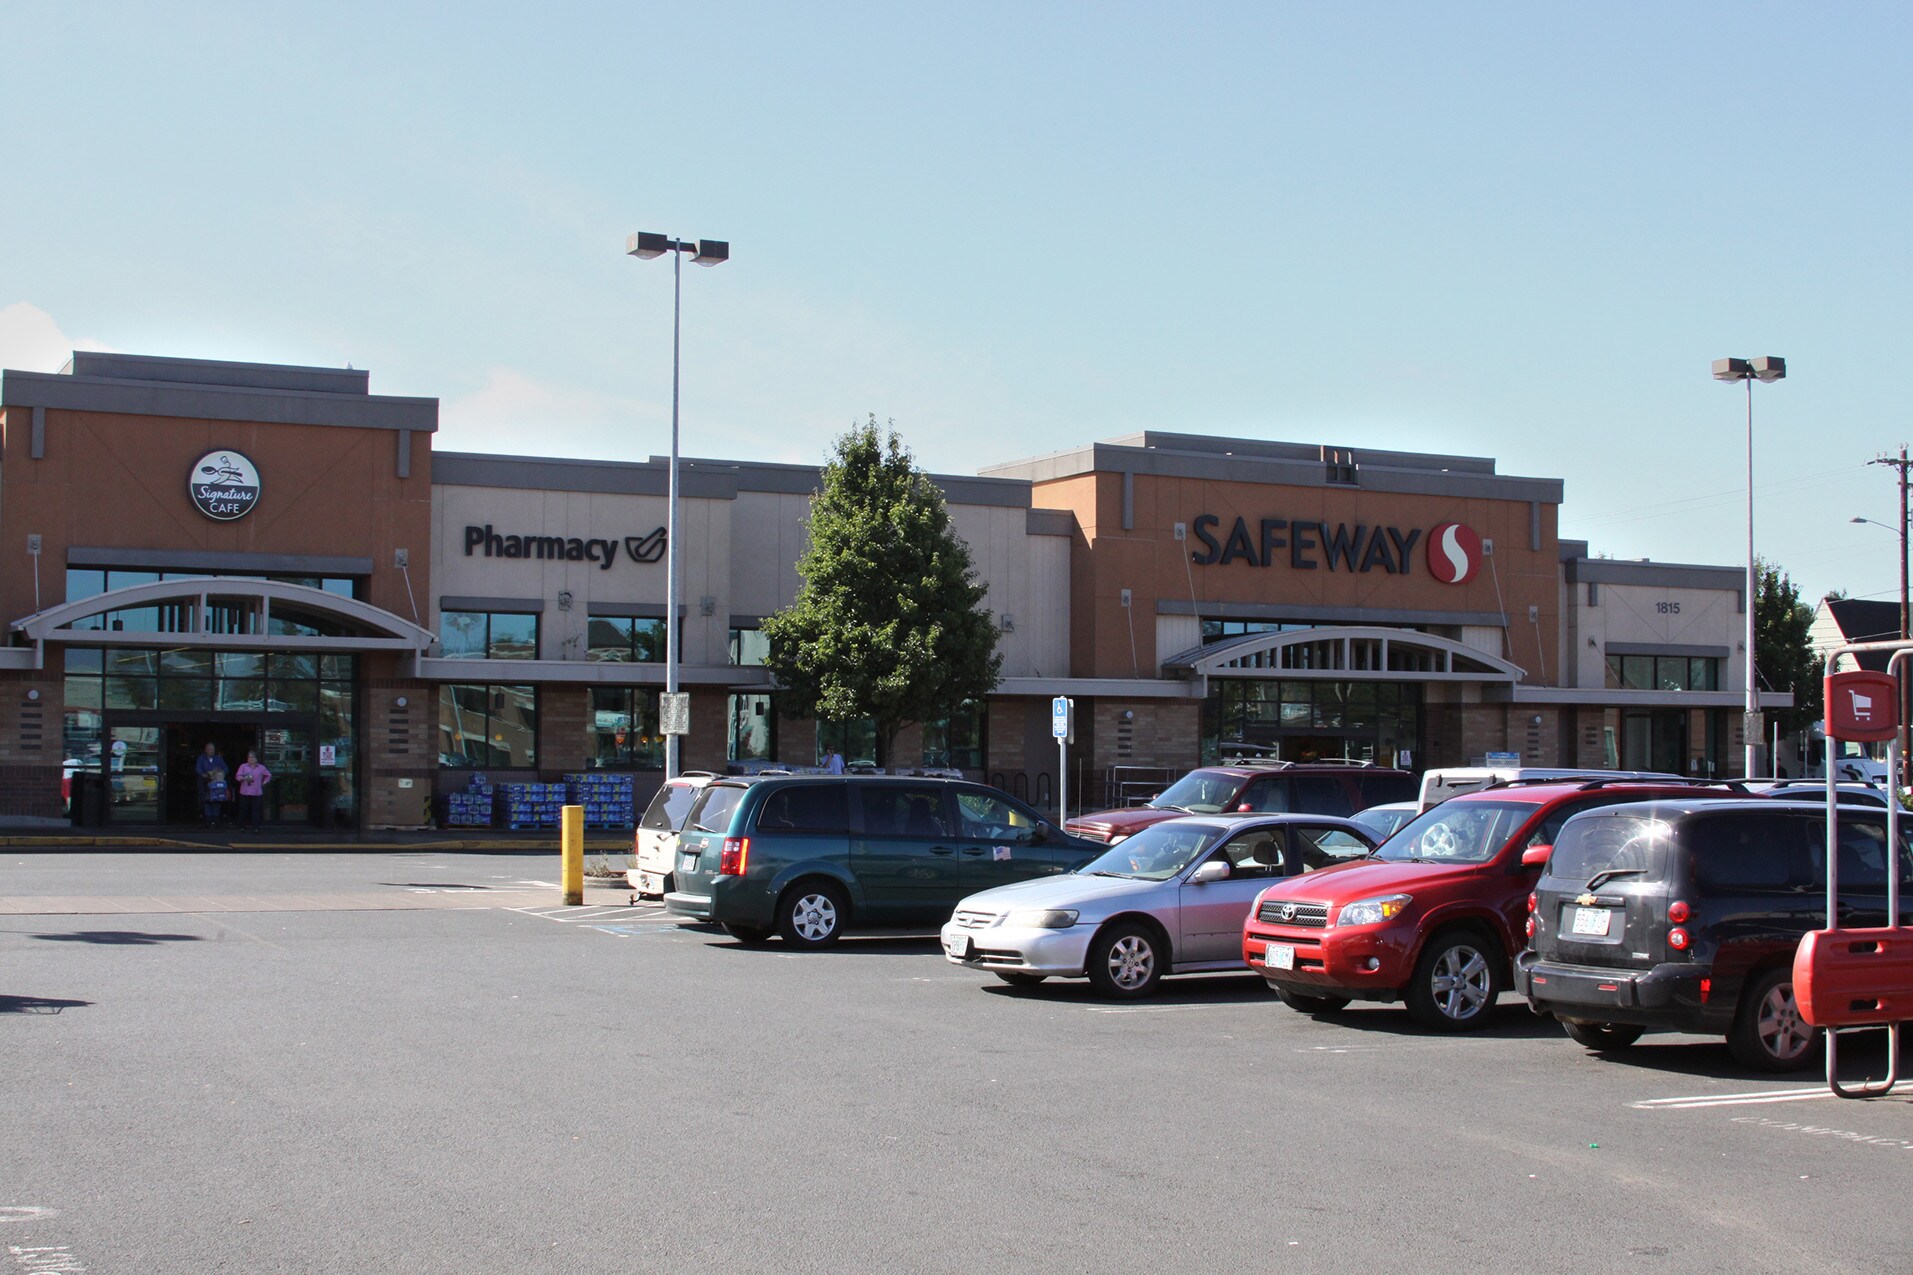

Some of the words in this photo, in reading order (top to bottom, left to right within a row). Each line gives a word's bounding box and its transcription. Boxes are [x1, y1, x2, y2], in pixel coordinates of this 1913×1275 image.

[197, 485, 254, 503] Signature
[209, 502, 240, 514] CAFE
[465, 524, 619, 571] Pharmacy
[1193, 514, 1422, 574] SAFEWAY
[1655, 602, 1681, 614] 1815
